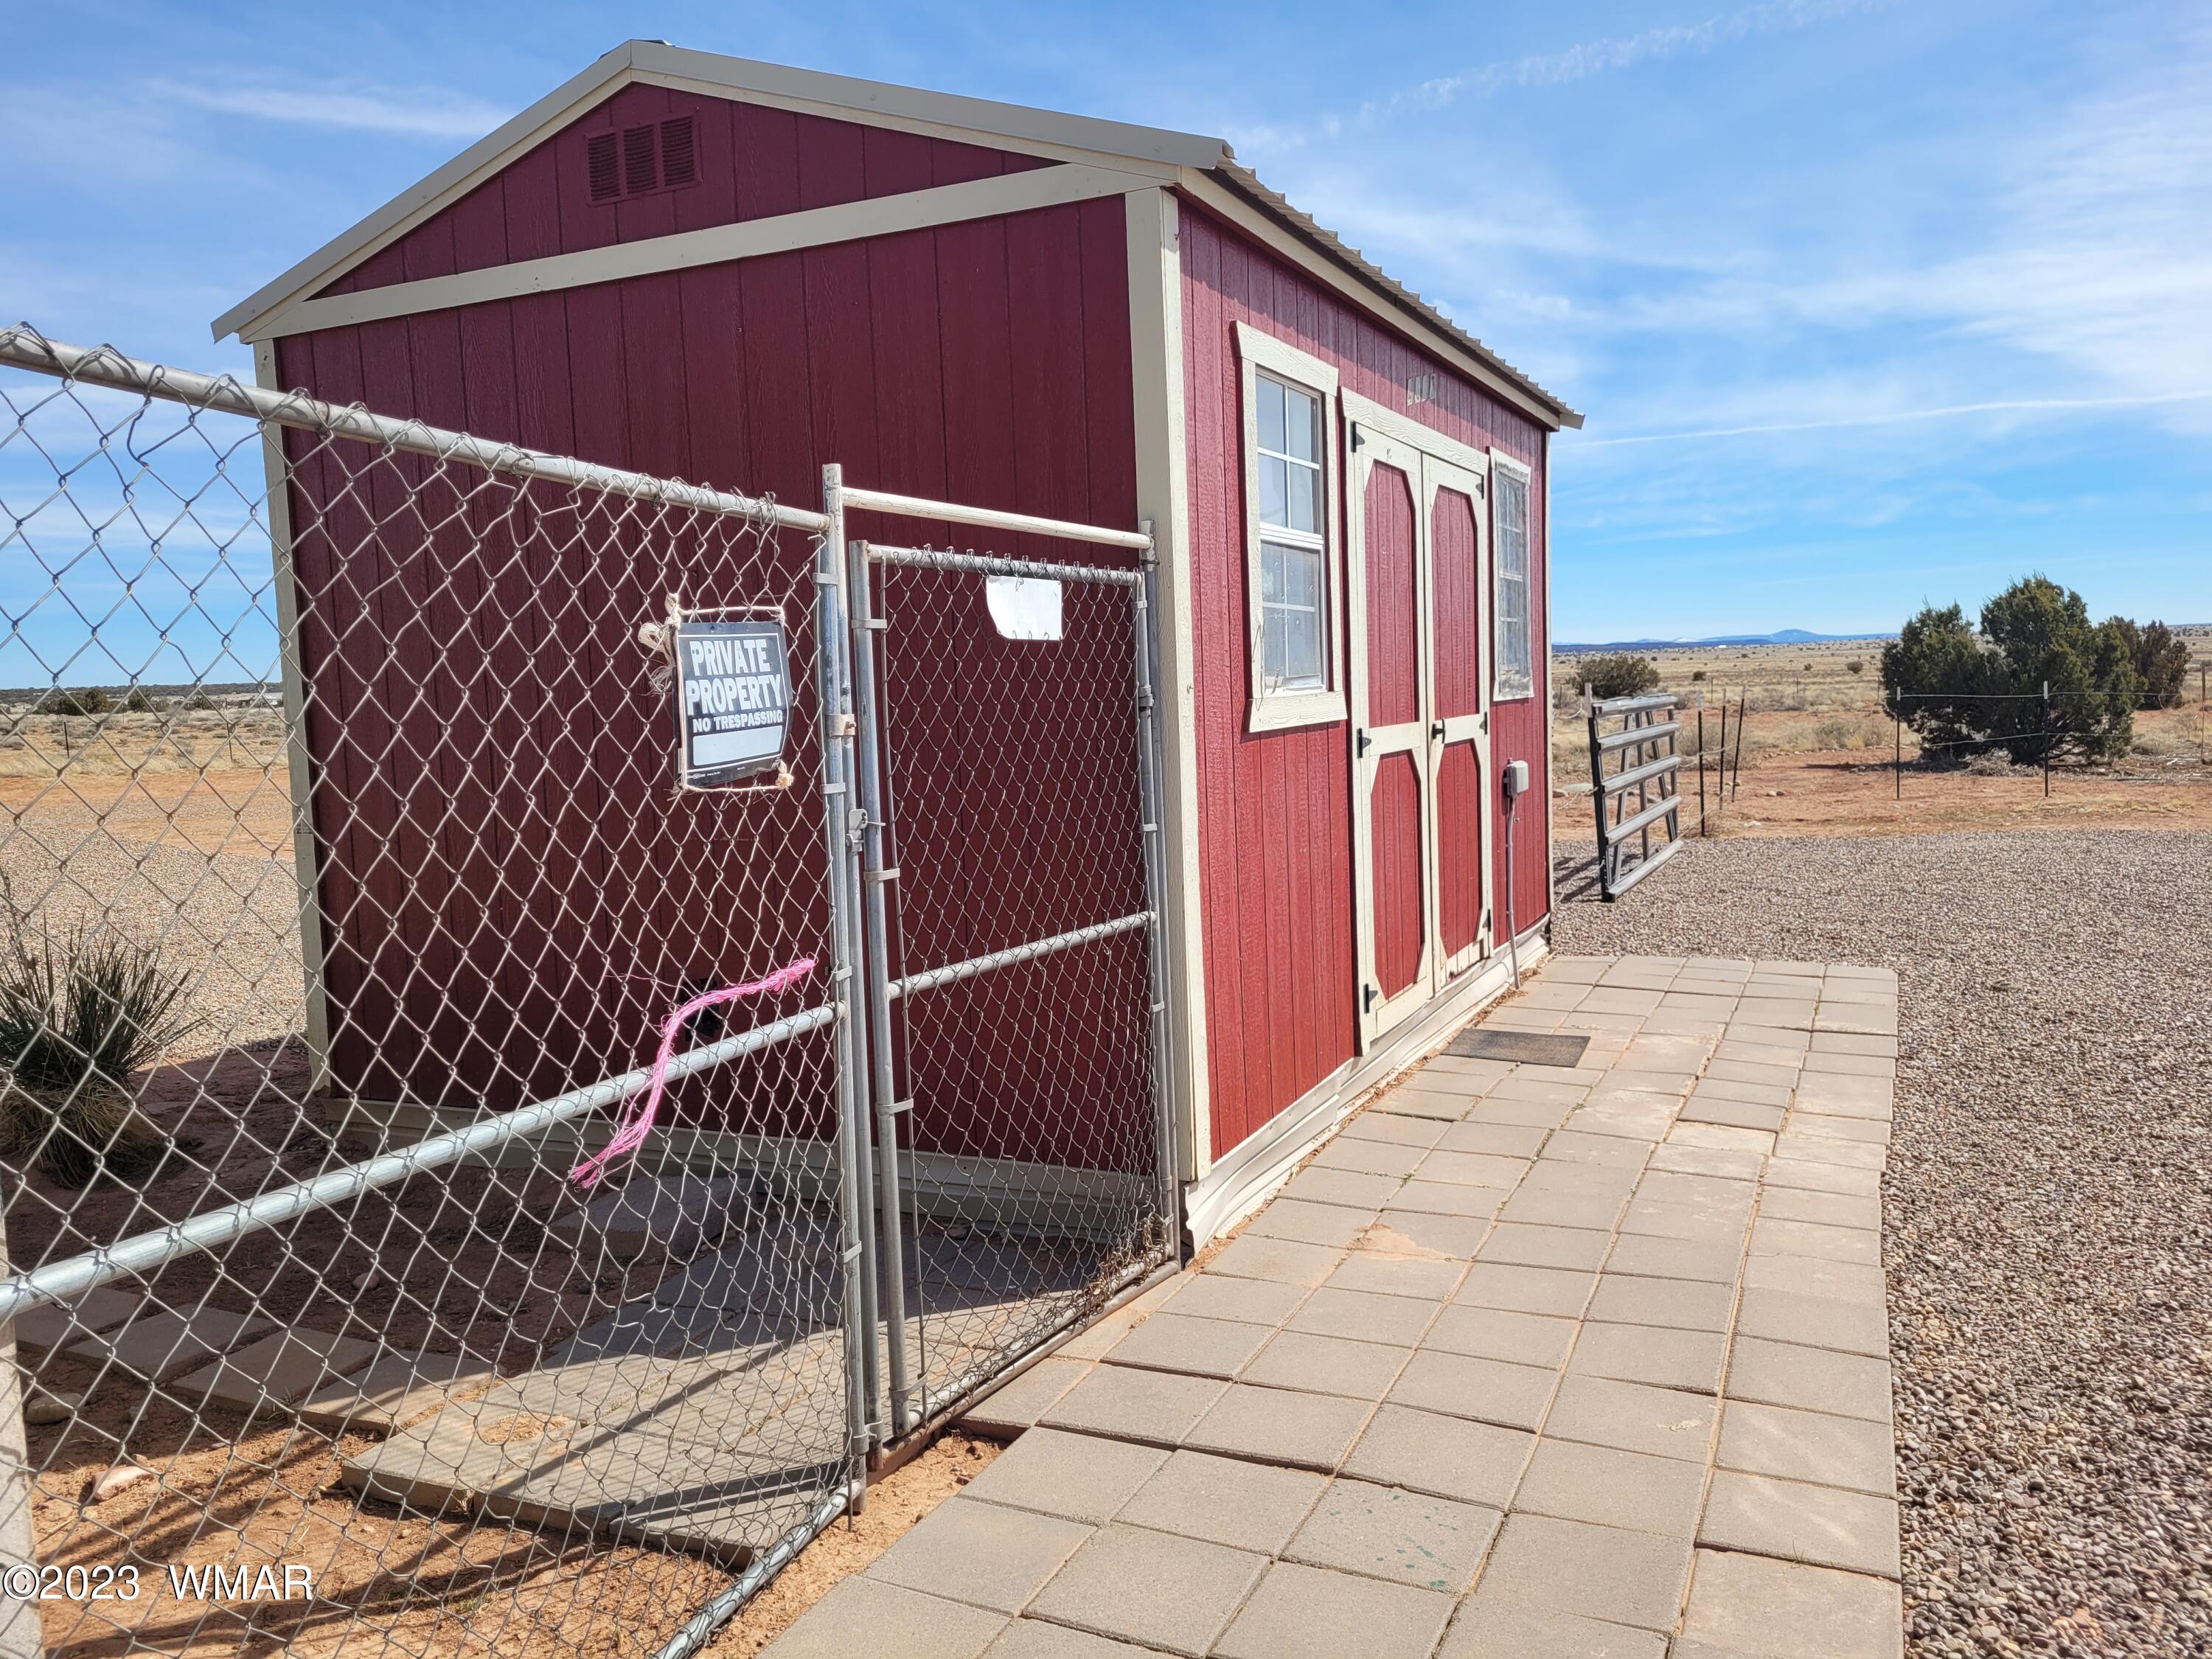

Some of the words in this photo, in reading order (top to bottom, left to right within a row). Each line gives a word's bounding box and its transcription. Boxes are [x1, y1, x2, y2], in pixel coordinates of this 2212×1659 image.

[689, 639, 771, 676] PRIVATE
[685, 674, 782, 716] PROPERTY
[692, 717, 711, 733] NO
[714, 709, 783, 731] TRESPASSING
